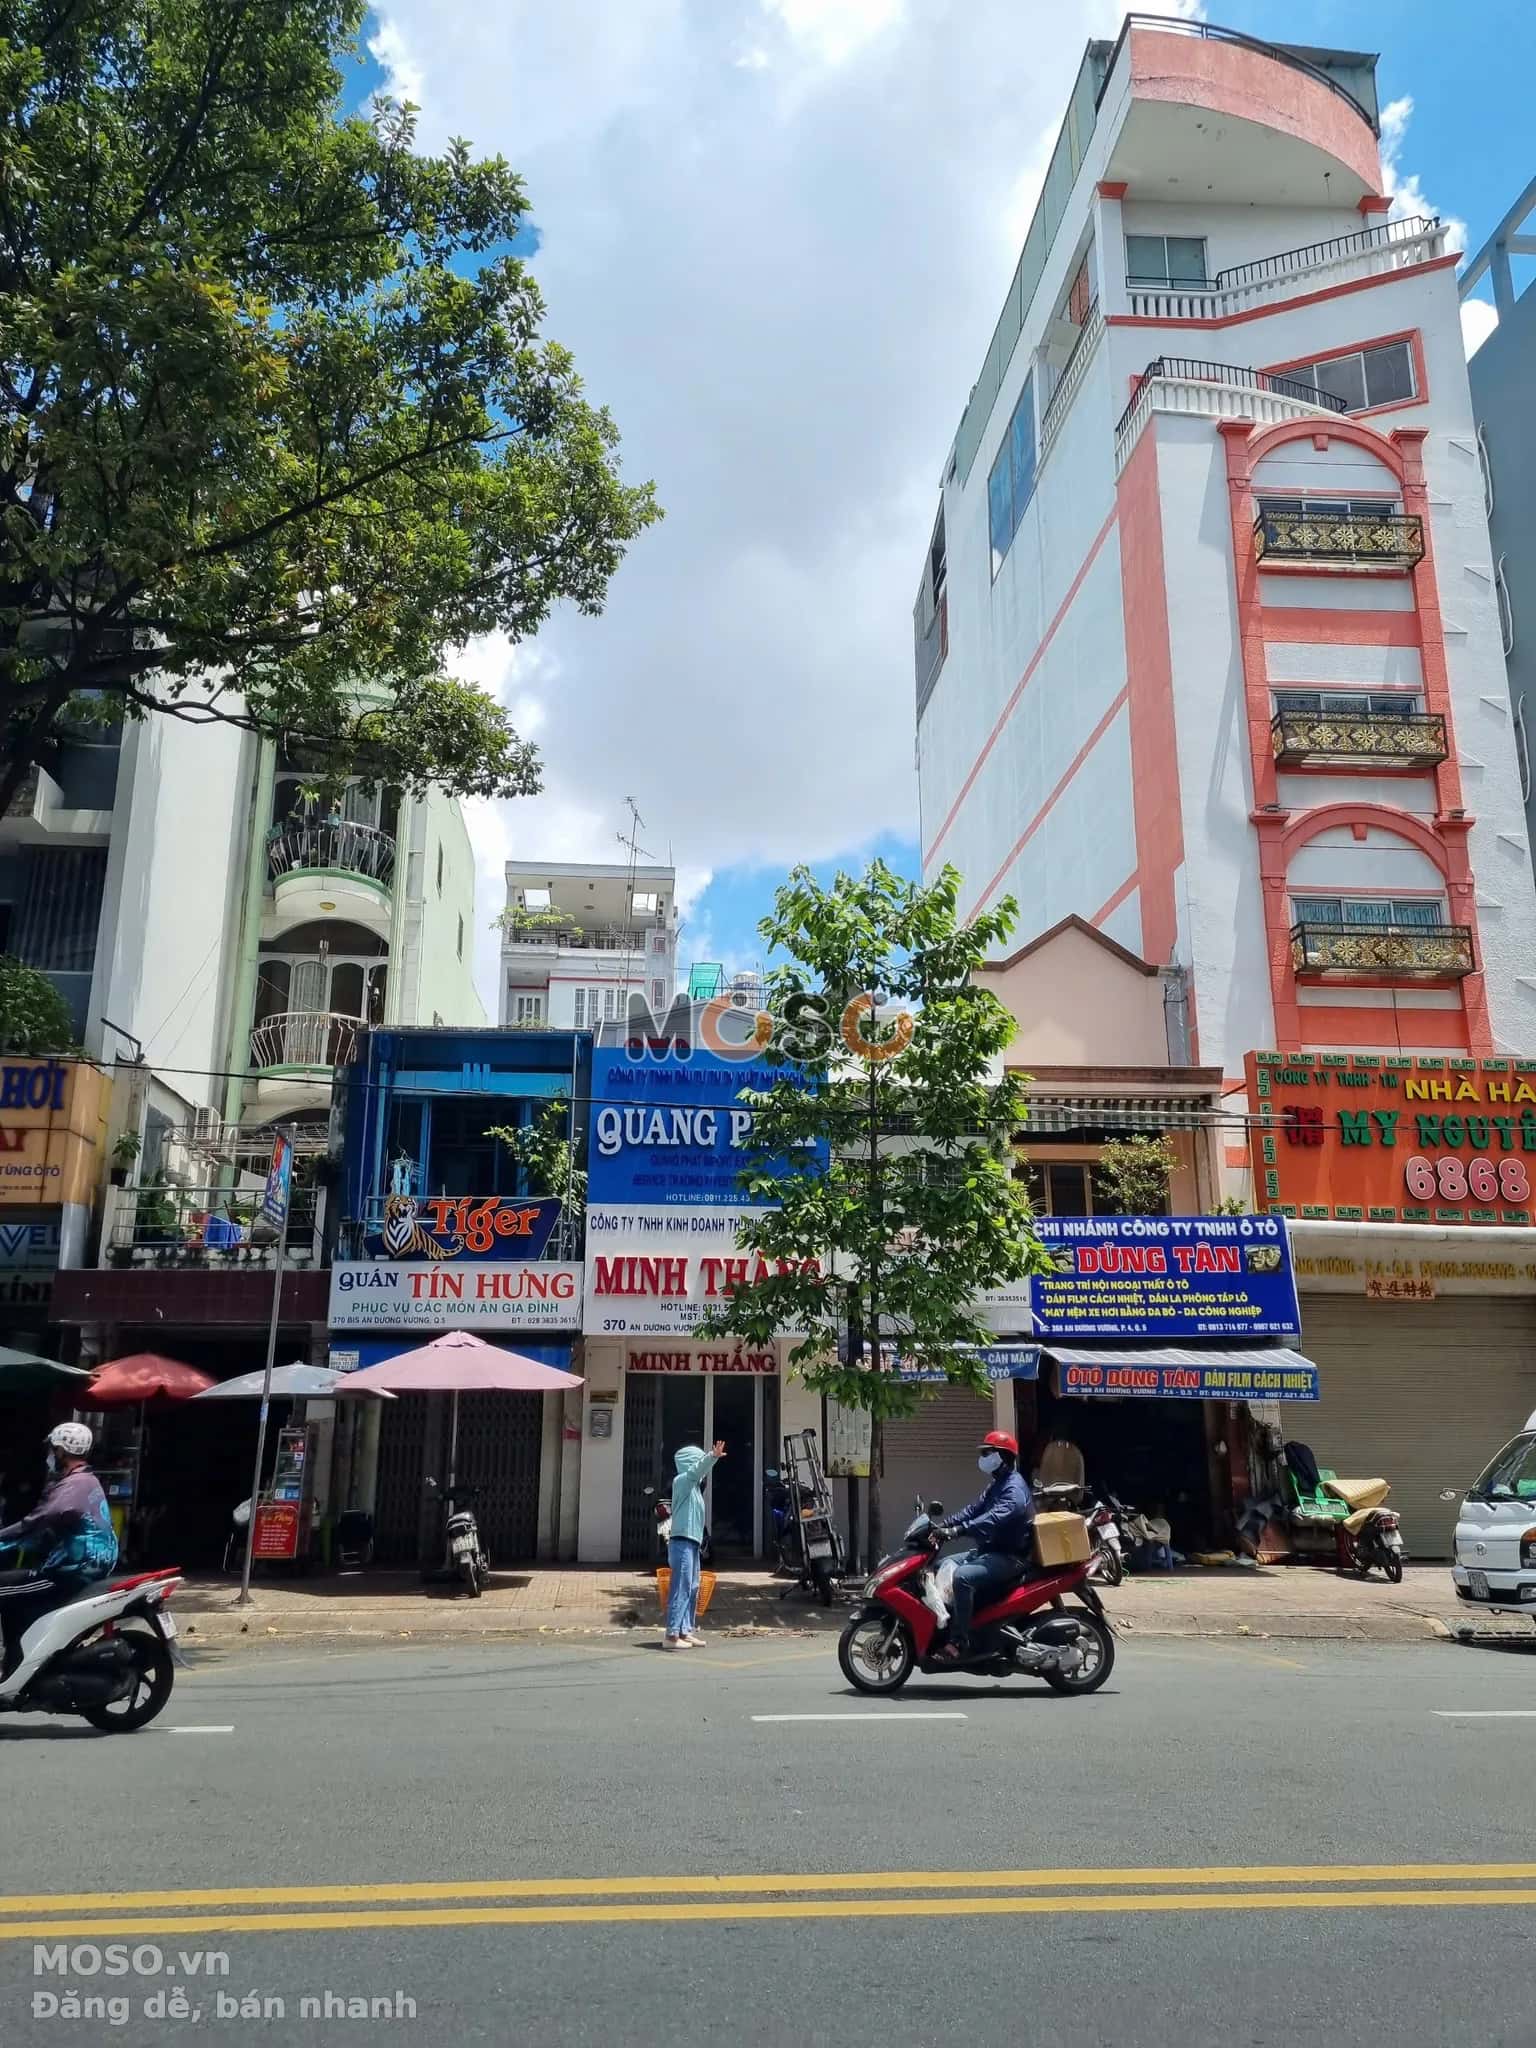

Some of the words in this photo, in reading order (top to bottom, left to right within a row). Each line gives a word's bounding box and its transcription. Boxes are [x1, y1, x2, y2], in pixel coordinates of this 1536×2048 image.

[1274, 1068, 1308, 1086] CÔNG
[1315, 1072, 1331, 1087] TY
[1337, 1072, 1370, 1087] TNHH
[1405, 1075, 1480, 1102] NHÀ
[597, 1107, 719, 1155] QUANG
[1405, 1156, 1530, 1202] 6868
[427, 1196, 541, 1252] Tiger
[590, 1212, 619, 1231] CÔNG
[622, 1217, 634, 1231] TY
[638, 1217, 664, 1231] TNHH
[666, 1217, 689, 1231] KINH
[692, 1217, 725, 1232] DOANH
[1033, 1222, 1060, 1238] CHI
[1063, 1219, 1118, 1236] NHÁNH
[1121, 1219, 1170, 1236] CÔNG
[1171, 1222, 1193, 1236] TY
[1195, 1222, 1238, 1236] TNHH
[1240, 1219, 1253, 1236] Ô
[1255, 1219, 1278, 1236] TÔ
[1077, 1242, 1168, 1273] DŨNG
[1173, 1242, 1242, 1273] TÂN
[339, 1269, 399, 1291] QUÁN
[407, 1265, 465, 1299] TÍN
[476, 1268, 574, 1299] HƯNG
[594, 1256, 689, 1296] MINH
[1076, 1279, 1090, 1290] TRÍ
[1092, 1279, 1109, 1292] NỘI
[1111, 1281, 1141, 1292] NGOẠI
[1176, 1279, 1190, 1289] TÔ
[352, 1302, 388, 1315] PHỤC
[393, 1302, 410, 1315] VỤ
[414, 1300, 442, 1313] CÁC
[446, 1300, 475, 1313] MÓN
[502, 1303, 524, 1313] GIA
[528, 1300, 559, 1313] ĐÌNH
[1046, 1293, 1066, 1304] DÁN
[1067, 1295, 1088, 1304] FILM
[1089, 1293, 1116, 1304] CÁCH
[1088, 1309, 1100, 1317] XE
[1147, 1308, 1161, 1317] DA
[1183, 1308, 1198, 1317] DA
[1198, 1305, 1227, 1316] CÔNG
[603, 1320, 626, 1332] 370
[630, 1324, 641, 1332] AN
[629, 1352, 692, 1372] MINH
[697, 1345, 776, 1373] THẮNG
[1107, 1366, 1159, 1388] DŨNG
[1162, 1366, 1200, 1389] TÂN
[1204, 1369, 1226, 1387] DÁN
[1227, 1371, 1251, 1388] FILM
[1253, 1370, 1281, 1389] CÁCH
[1282, 1370, 1313, 1392] NHIỆT
